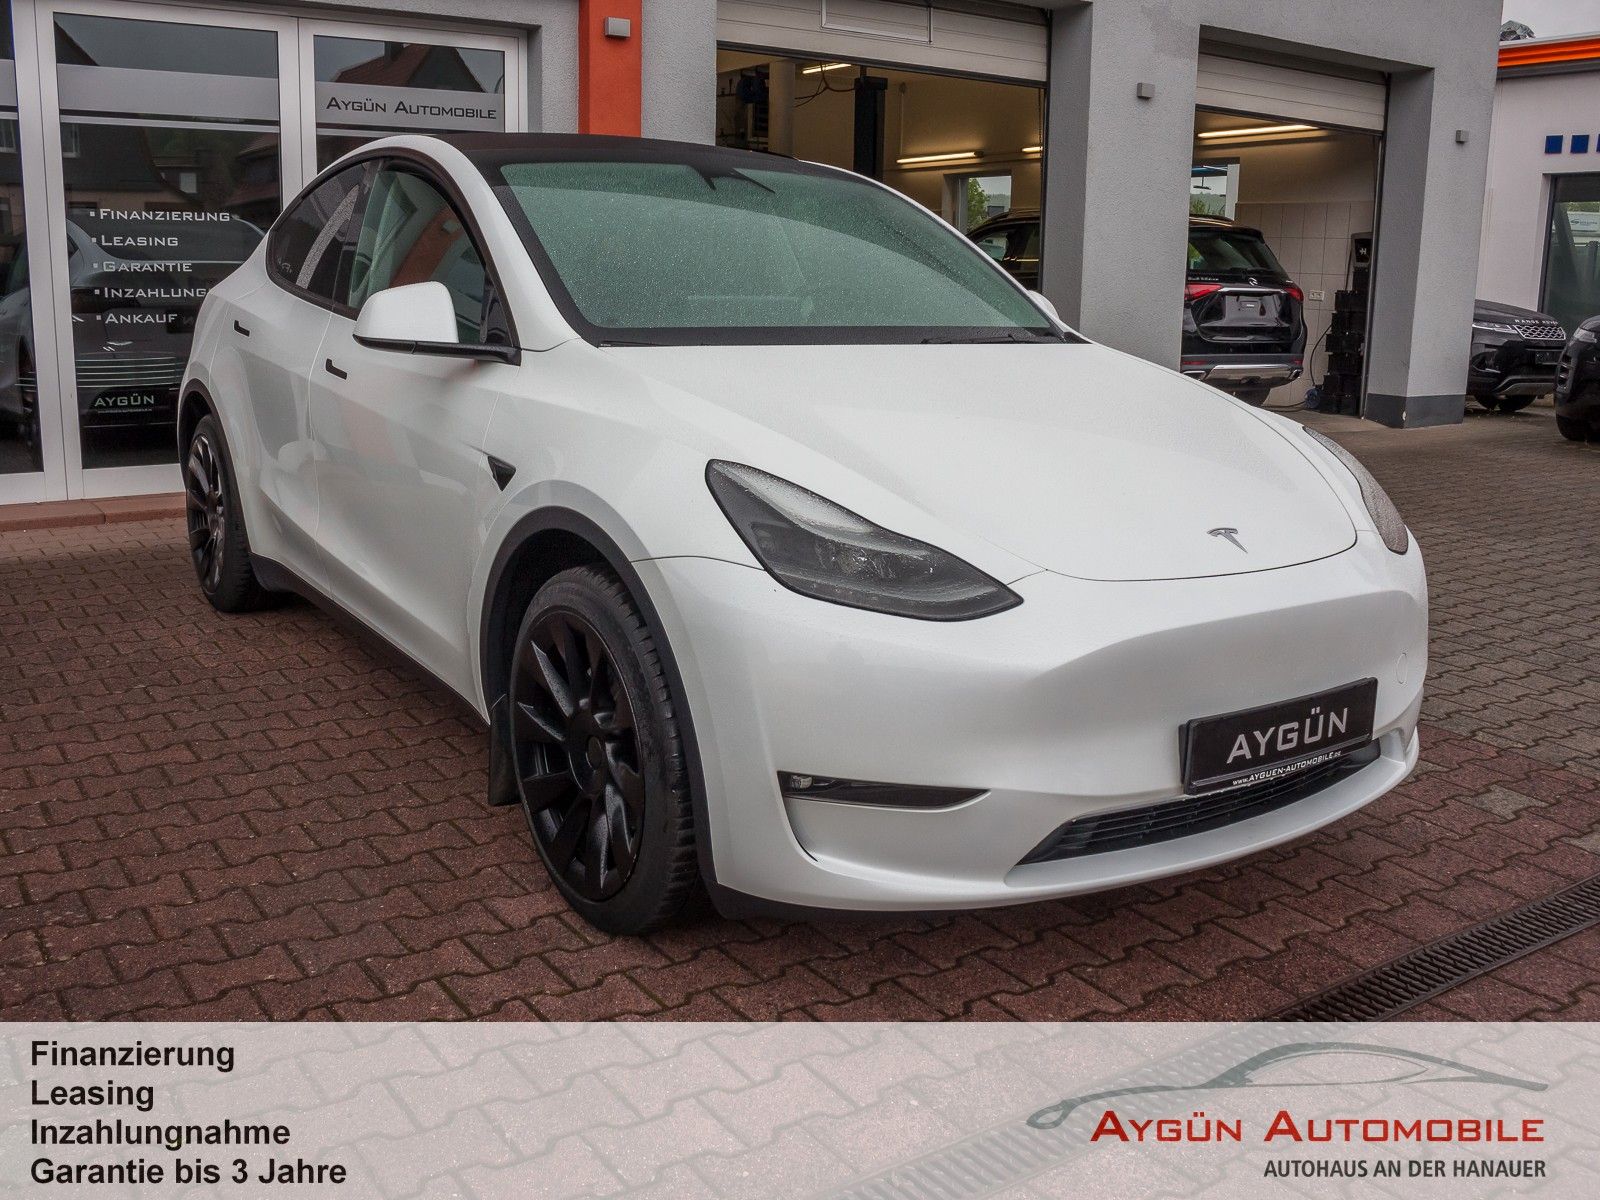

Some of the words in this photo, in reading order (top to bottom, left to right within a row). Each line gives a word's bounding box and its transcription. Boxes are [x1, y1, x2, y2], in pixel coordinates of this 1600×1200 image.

[326, 97, 387, 113] AYGÜN
[394, 101, 497, 120] AUTOMOBILE
[100, 208, 231, 222] FINANZIERUNG
[101, 235, 179, 247] LEASING
[103, 261, 193, 272] GARANTIE
[104, 287, 210, 298] INZAHLUNG
[105, 313, 178, 324] ANKAUF
[94, 393, 155, 407] AYGÜN
[1226, 706, 1348, 764] AYGÜN
